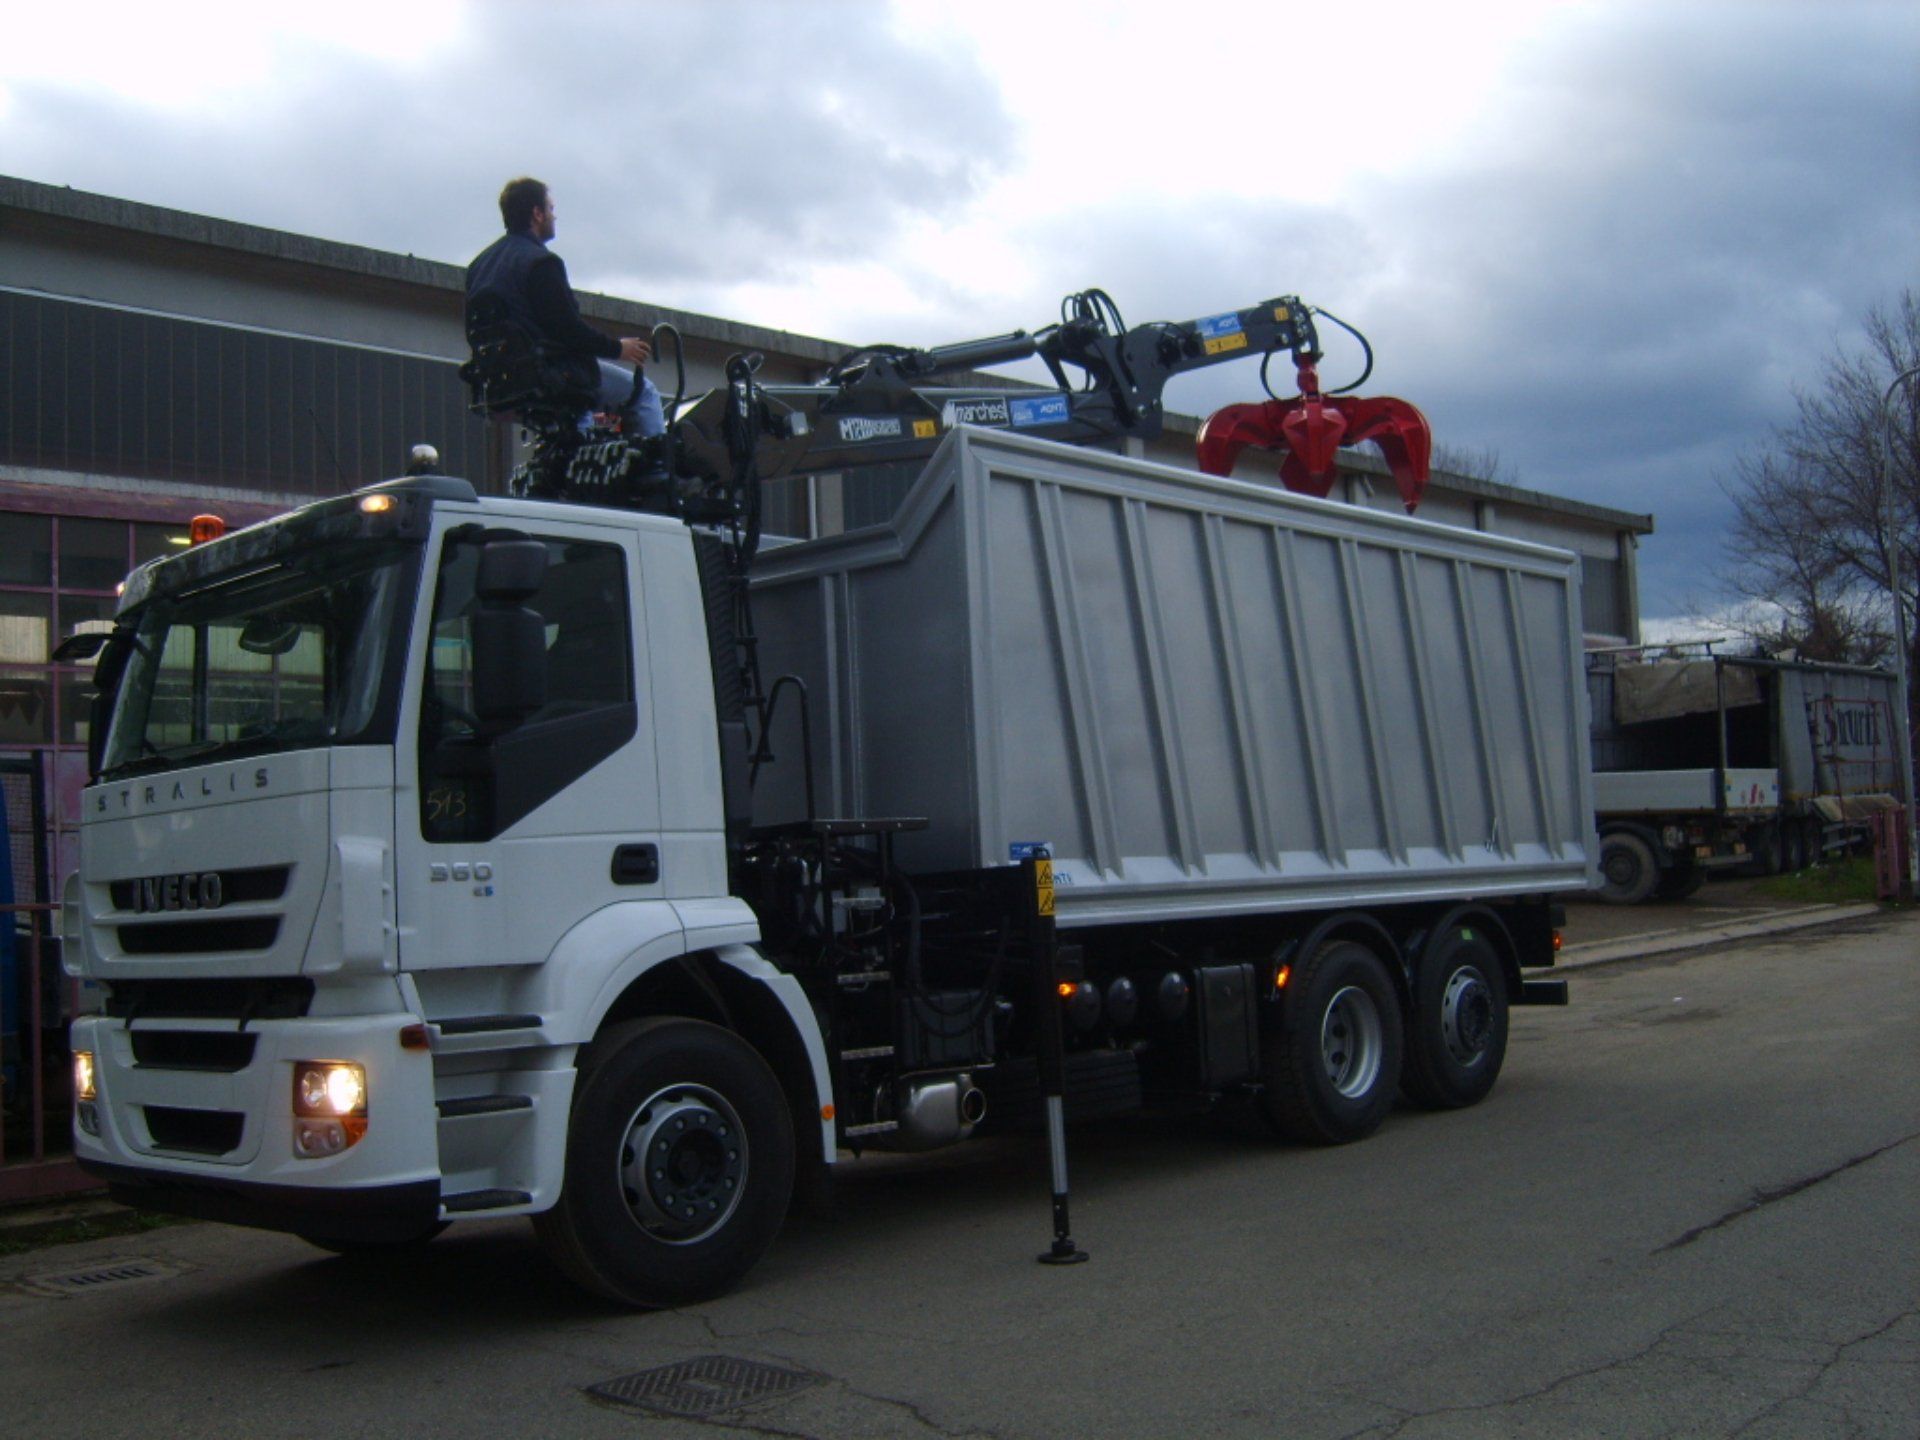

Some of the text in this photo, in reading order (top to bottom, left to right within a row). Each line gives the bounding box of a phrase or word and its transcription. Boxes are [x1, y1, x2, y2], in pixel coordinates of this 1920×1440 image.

[98, 768, 268, 812] STRALIS
[426, 787, 467, 820] 513
[429, 861, 493, 882] 360
[133, 873, 222, 914] IVECO
